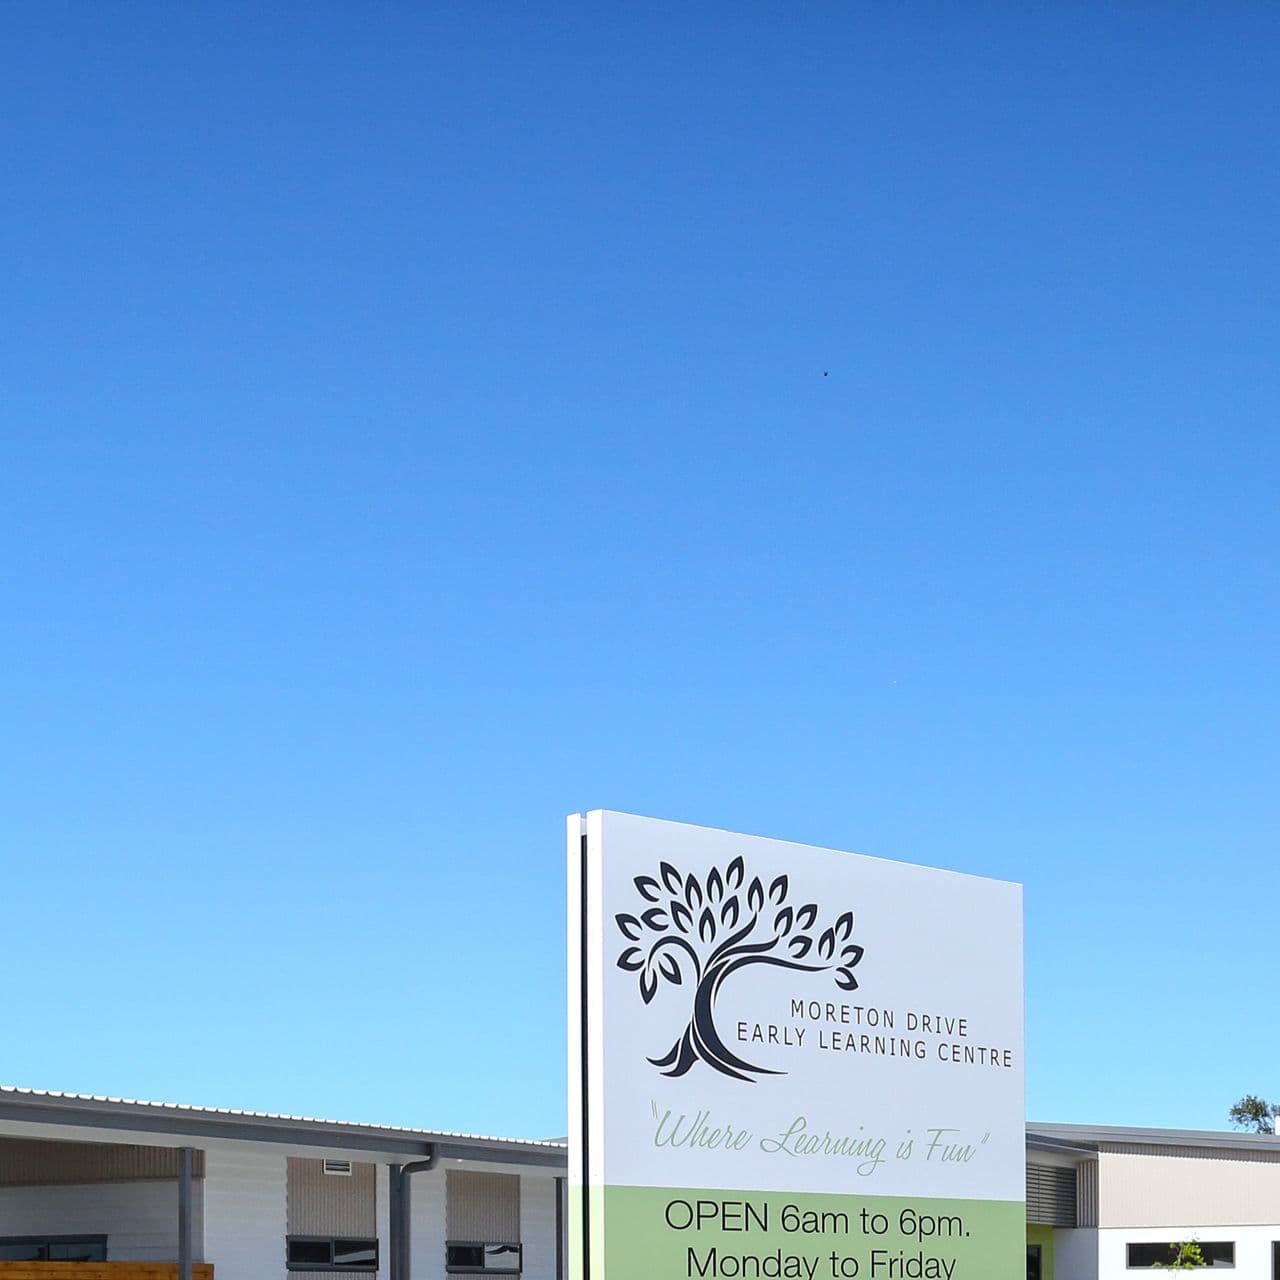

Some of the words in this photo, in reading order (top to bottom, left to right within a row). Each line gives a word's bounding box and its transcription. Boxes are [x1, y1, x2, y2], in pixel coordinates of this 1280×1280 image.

[790, 999, 896, 1029] MORETON
[906, 1012, 968, 1037] DRIVE
[736, 1021, 807, 1047] EARLY
[818, 1030, 927, 1060] LEARNING
[937, 1042, 1013, 1068] CENTRE
[760, 1116, 890, 1177] Learning
[894, 1130, 915, 1161] is
[664, 1200, 768, 1233] OPEN
[780, 1204, 849, 1235] 6am
[861, 1208, 889, 1237] to
[898, 1208, 971, 1243] 6pm.
[829, 1250, 859, 1279] to
